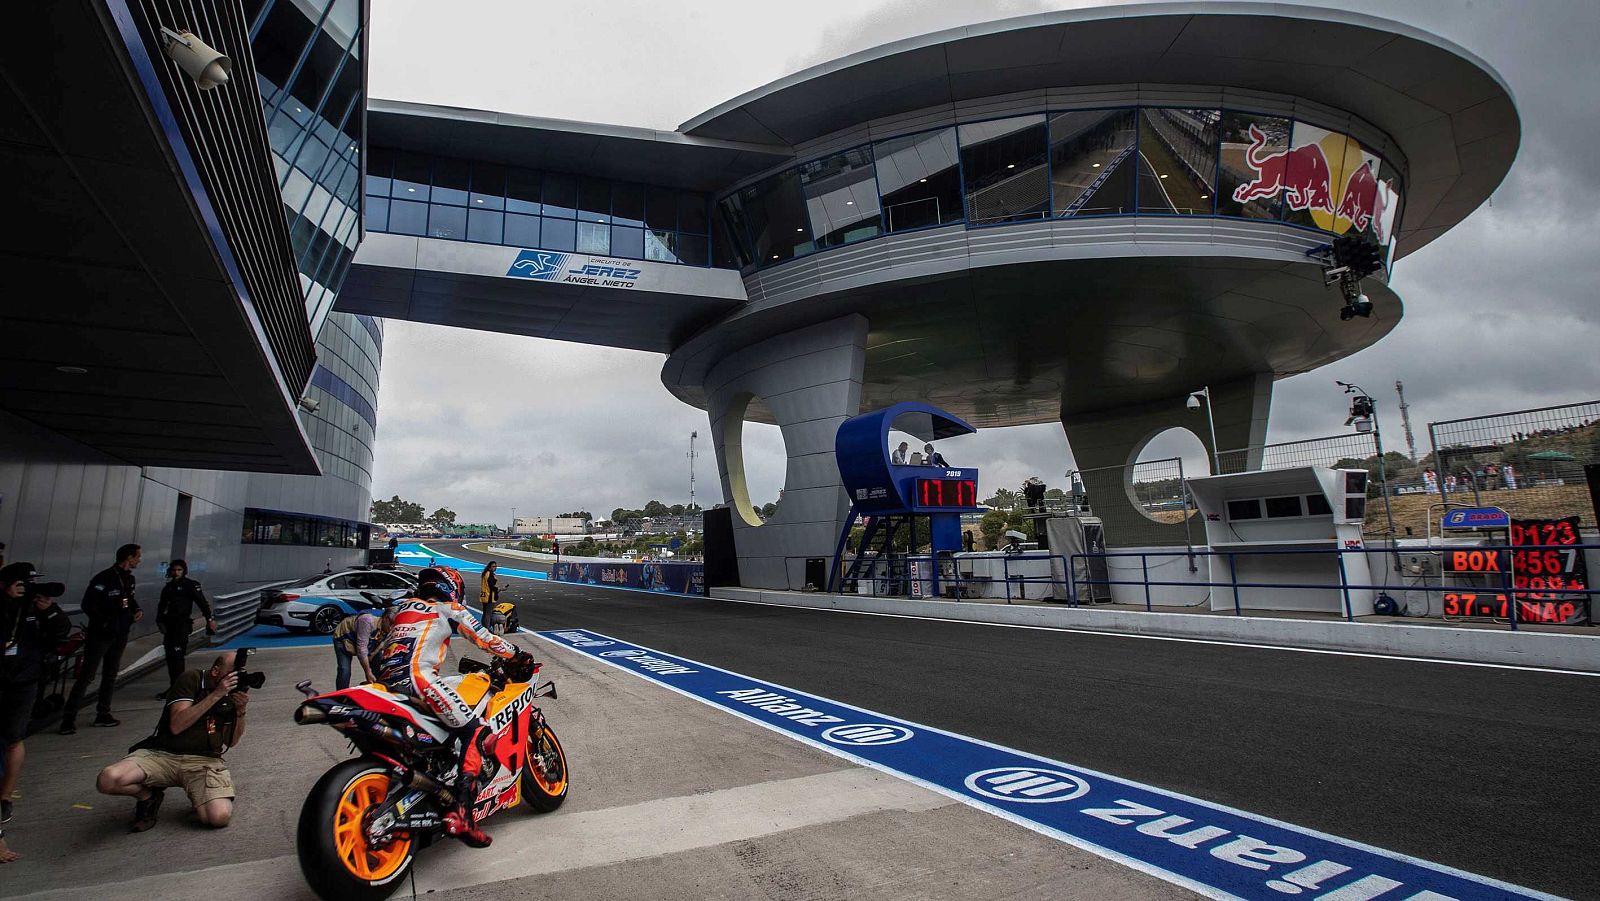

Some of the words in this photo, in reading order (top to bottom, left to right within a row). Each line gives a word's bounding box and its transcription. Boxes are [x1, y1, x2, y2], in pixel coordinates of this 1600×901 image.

[568, 264, 642, 280] JEREZ
[590, 258, 620, 266] CIRCUITO
[563, 274, 600, 286] ÁNGEL
[602, 279, 635, 289] NIETO
[1453, 551, 1500, 572] BOX
[399, 601, 433, 613] PSOL
[1521, 601, 1575, 623] MAP
[495, 682, 537, 730] REPSOL
[716, 688, 845, 727] Allianz
[1079, 798, 1461, 901] lianz
